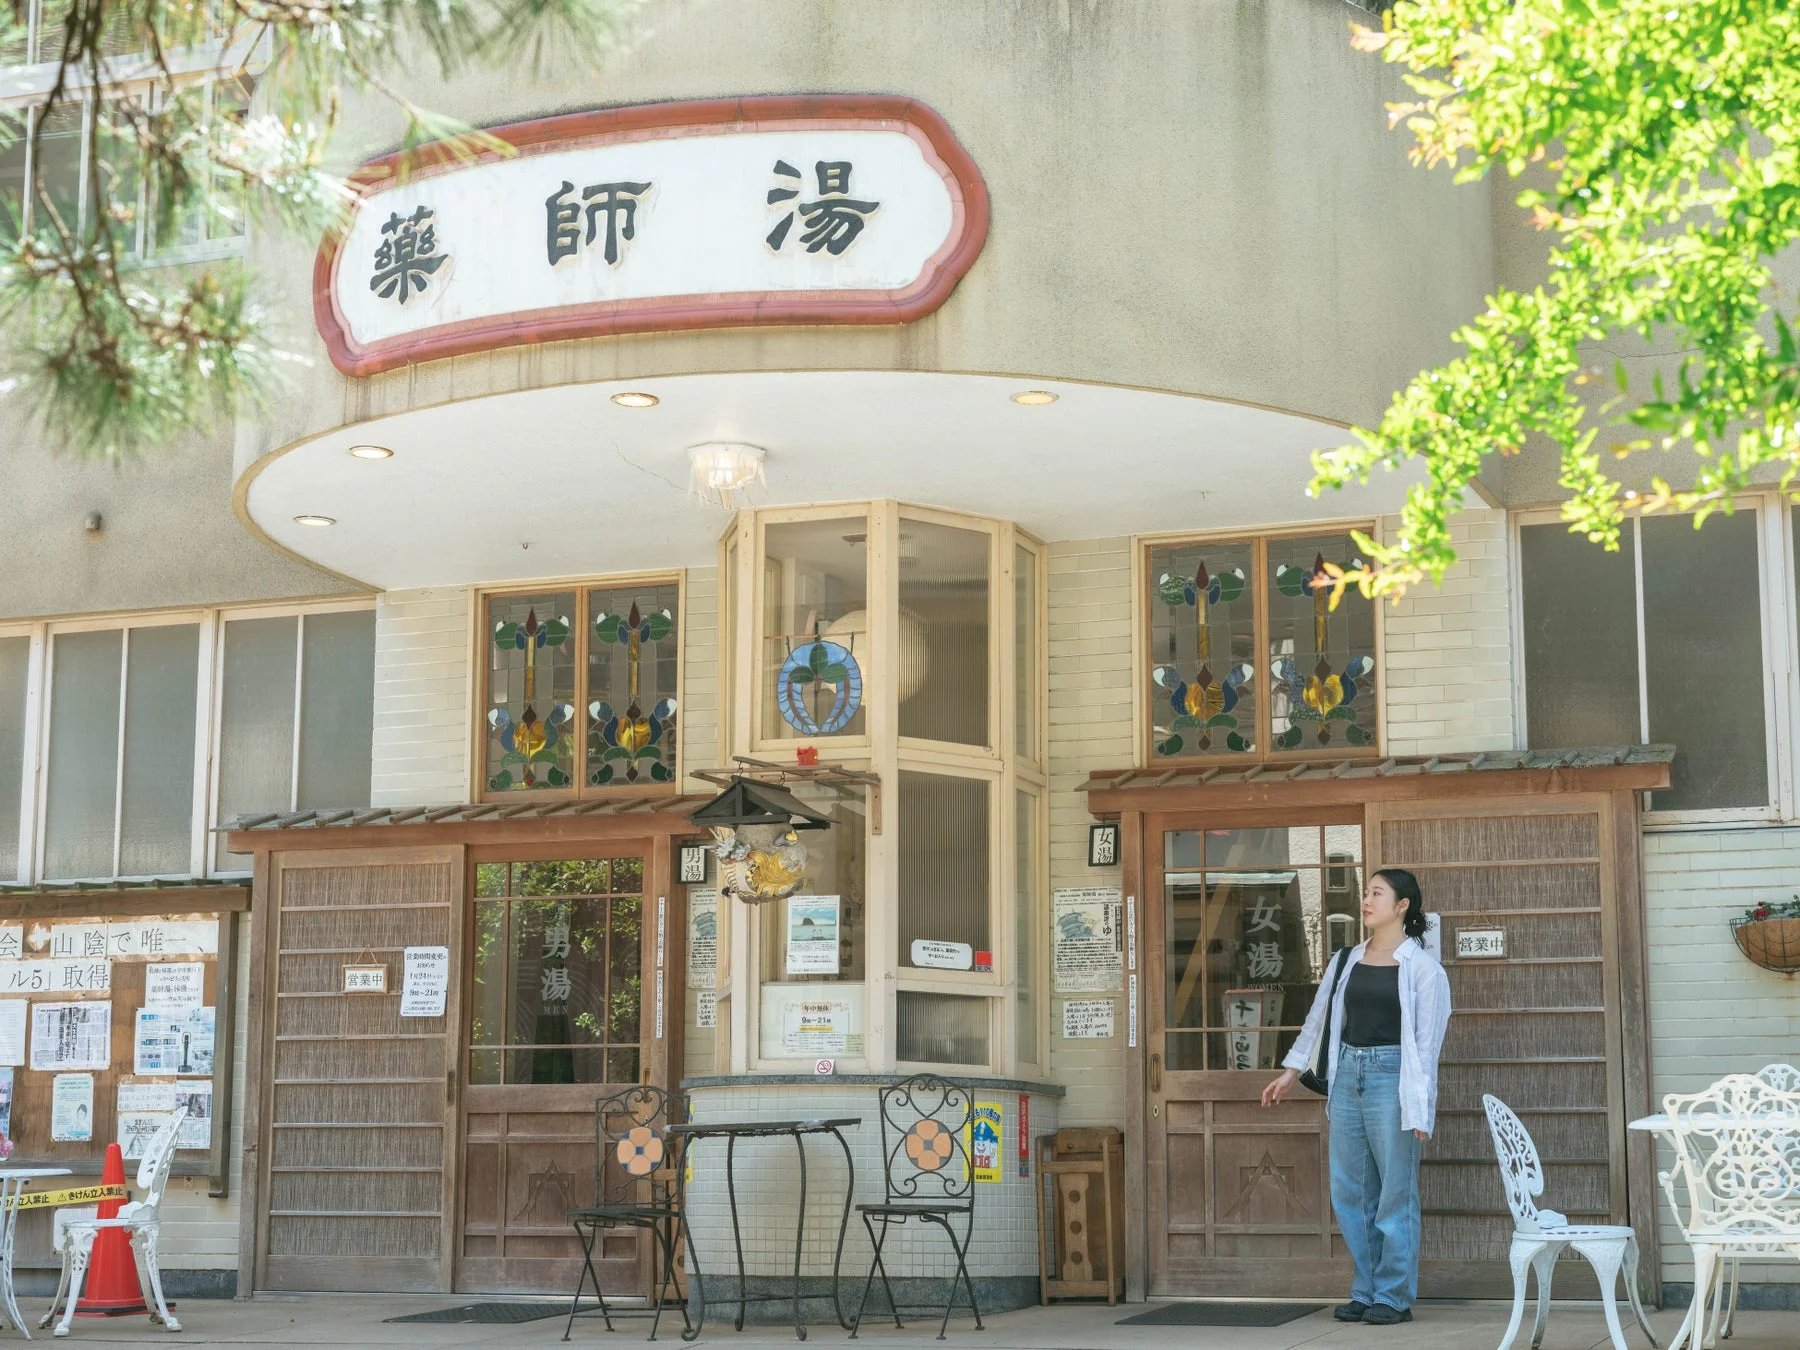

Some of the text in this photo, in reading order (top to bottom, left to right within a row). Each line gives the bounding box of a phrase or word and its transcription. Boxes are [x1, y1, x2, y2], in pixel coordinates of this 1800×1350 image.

[1097, 828, 1113, 864] 女湯
[684, 848, 701, 881] 男湯
[1246, 896, 1284, 979] 女湯
[1459, 936, 1503, 952] 営業中
[541, 926, 572, 1001] 男湯
[347, 973, 383, 987] 営業中
[1247, 984, 1284, 992] WOMEN
[68, 1186, 124, 1201] きけん立入禁止
